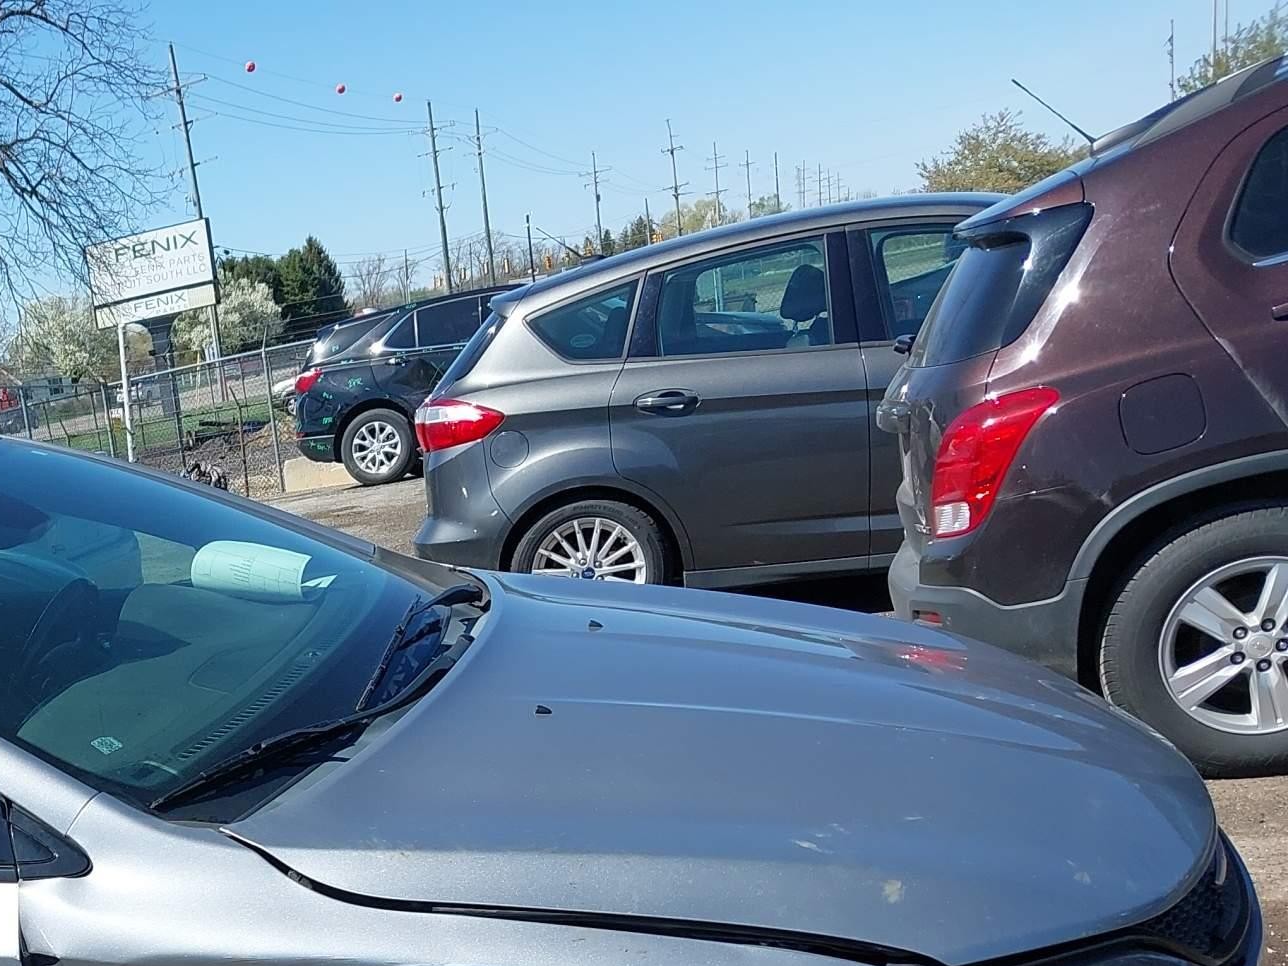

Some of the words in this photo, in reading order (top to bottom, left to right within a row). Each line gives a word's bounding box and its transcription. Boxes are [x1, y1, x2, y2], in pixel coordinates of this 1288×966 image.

[114, 230, 199, 262] FENIX
[168, 252, 205, 272] PARTS
[146, 267, 183, 286] SOUTH
[133, 291, 187, 313] FENIX
